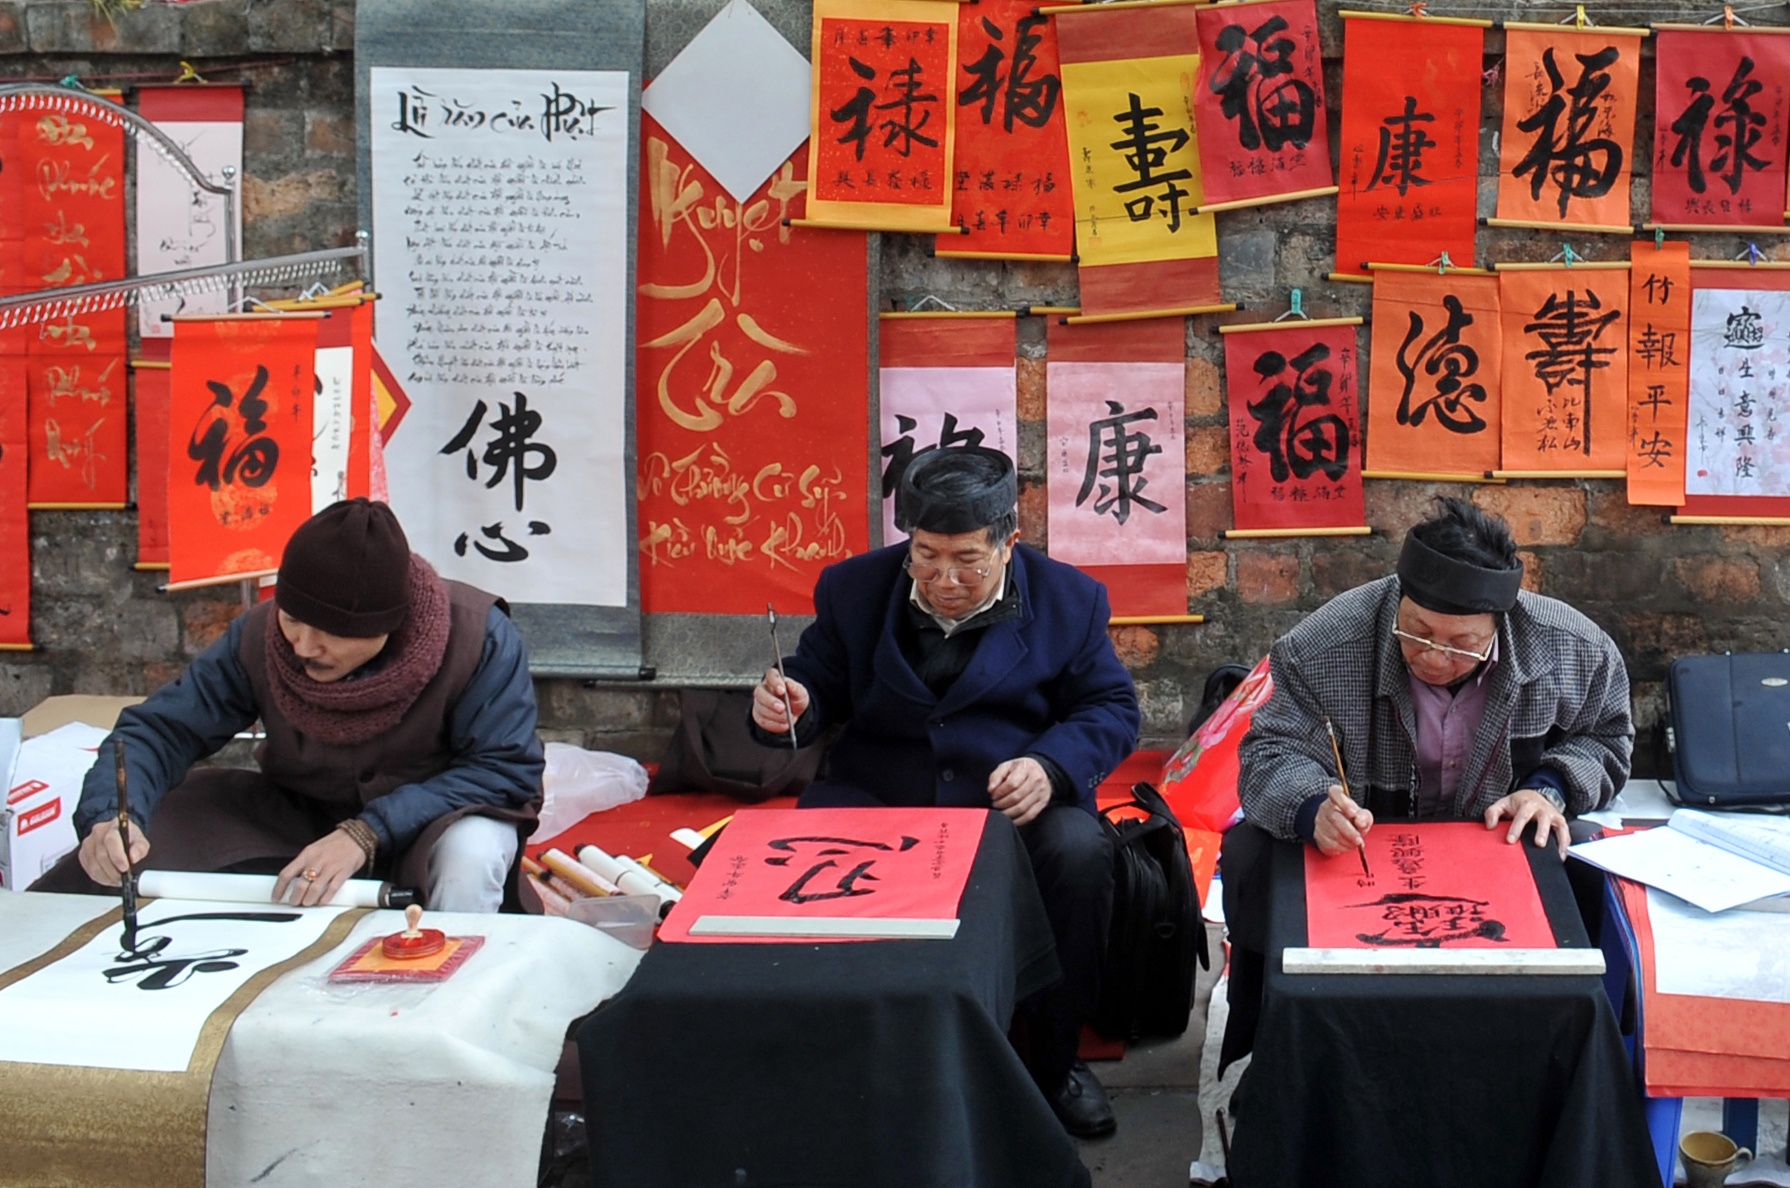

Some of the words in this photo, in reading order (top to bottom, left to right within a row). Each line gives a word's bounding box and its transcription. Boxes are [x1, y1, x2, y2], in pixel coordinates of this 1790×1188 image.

[958, 15, 1061, 133] 福
[1209, 15, 1315, 152] 福
[1512, 46, 1623, 219] 福
[1110, 92, 1192, 233] 壽
[1364, 96, 1436, 197] 康
[188, 364, 279, 492] 福
[1246, 342, 1350, 483] 福
[1635, 273, 1681, 468] 竹報平安
[1734, 358, 1757, 478] 生意興隆
[438, 391, 557, 562] 佛心
[1076, 400, 1168, 526] 康
